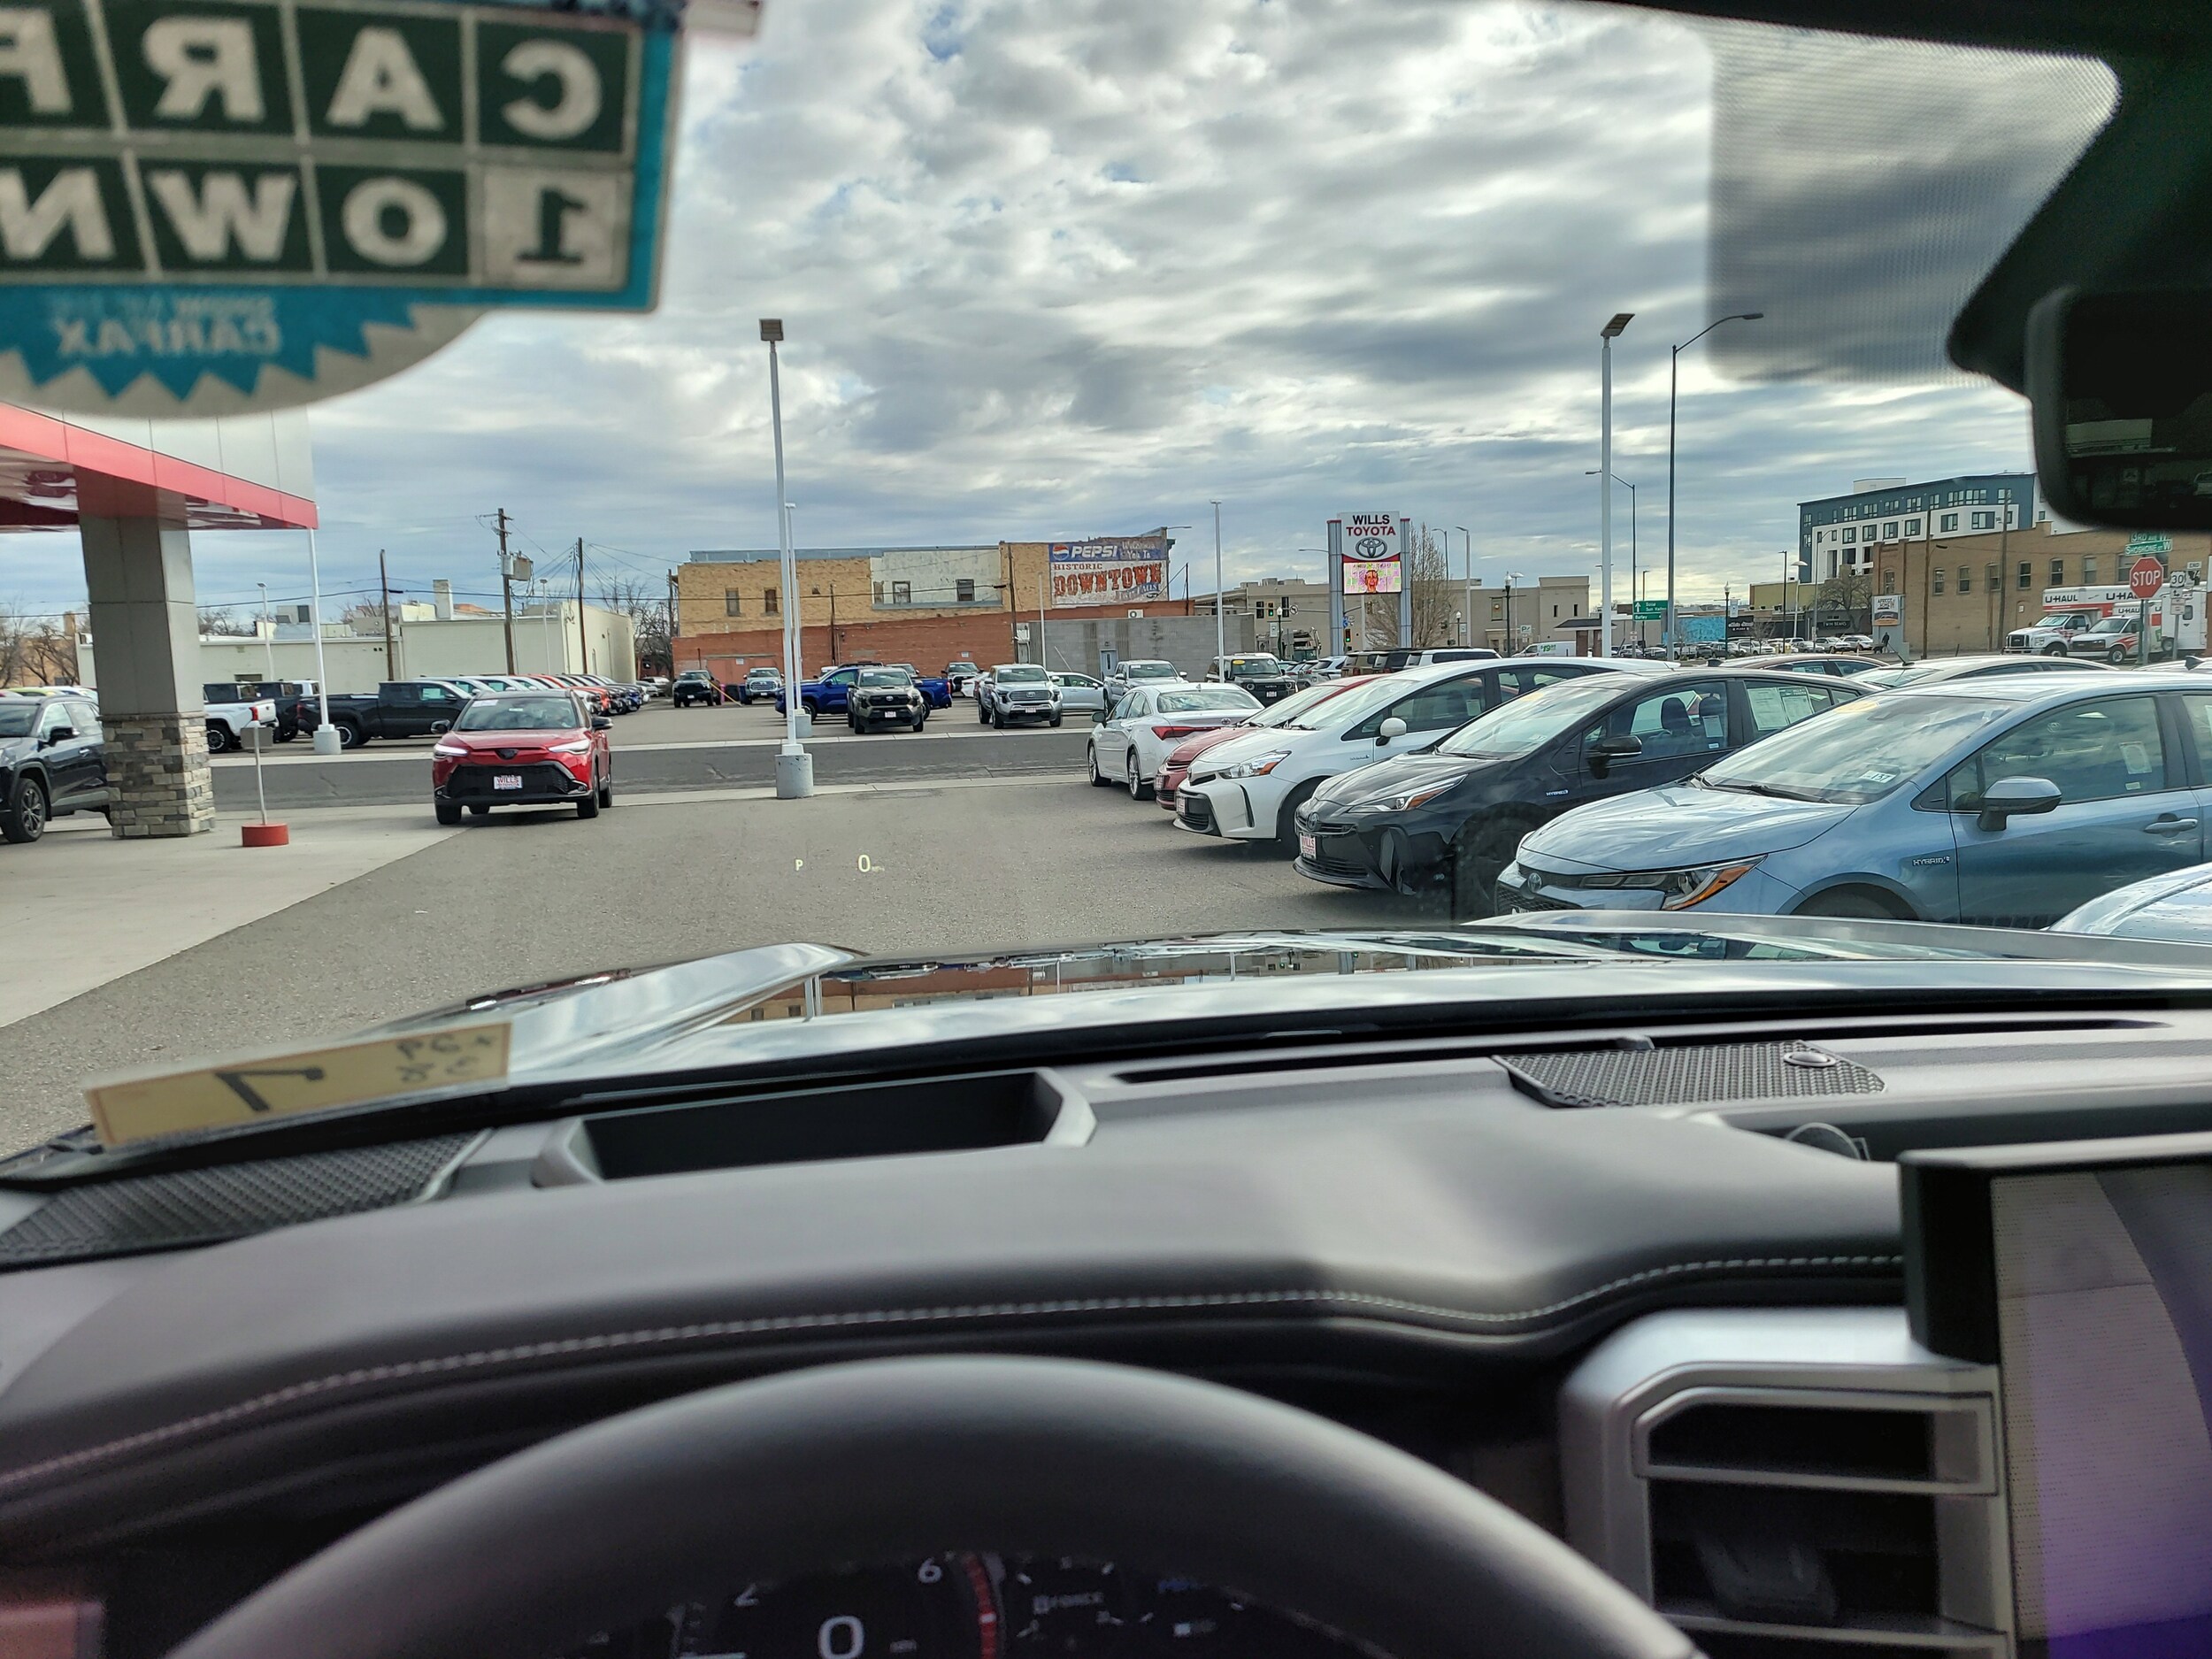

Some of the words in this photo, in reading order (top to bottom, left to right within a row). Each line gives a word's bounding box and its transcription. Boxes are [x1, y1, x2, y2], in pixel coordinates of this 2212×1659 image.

[1352, 514, 1390, 526] WILLS
[1346, 526, 1397, 536] TOYOTA
[1071, 545, 1118, 558] PEPSI
[2163, 541, 2171, 550] W
[1054, 563, 1162, 596] DOWNTOWN
[2131, 570, 2161, 587] STOP
[2171, 574, 2185, 584] 30
[795, 858, 803, 872] P
[857, 854, 871, 872] 0
[918, 1558, 941, 1584] 6
[818, 1615, 864, 1659] 0
